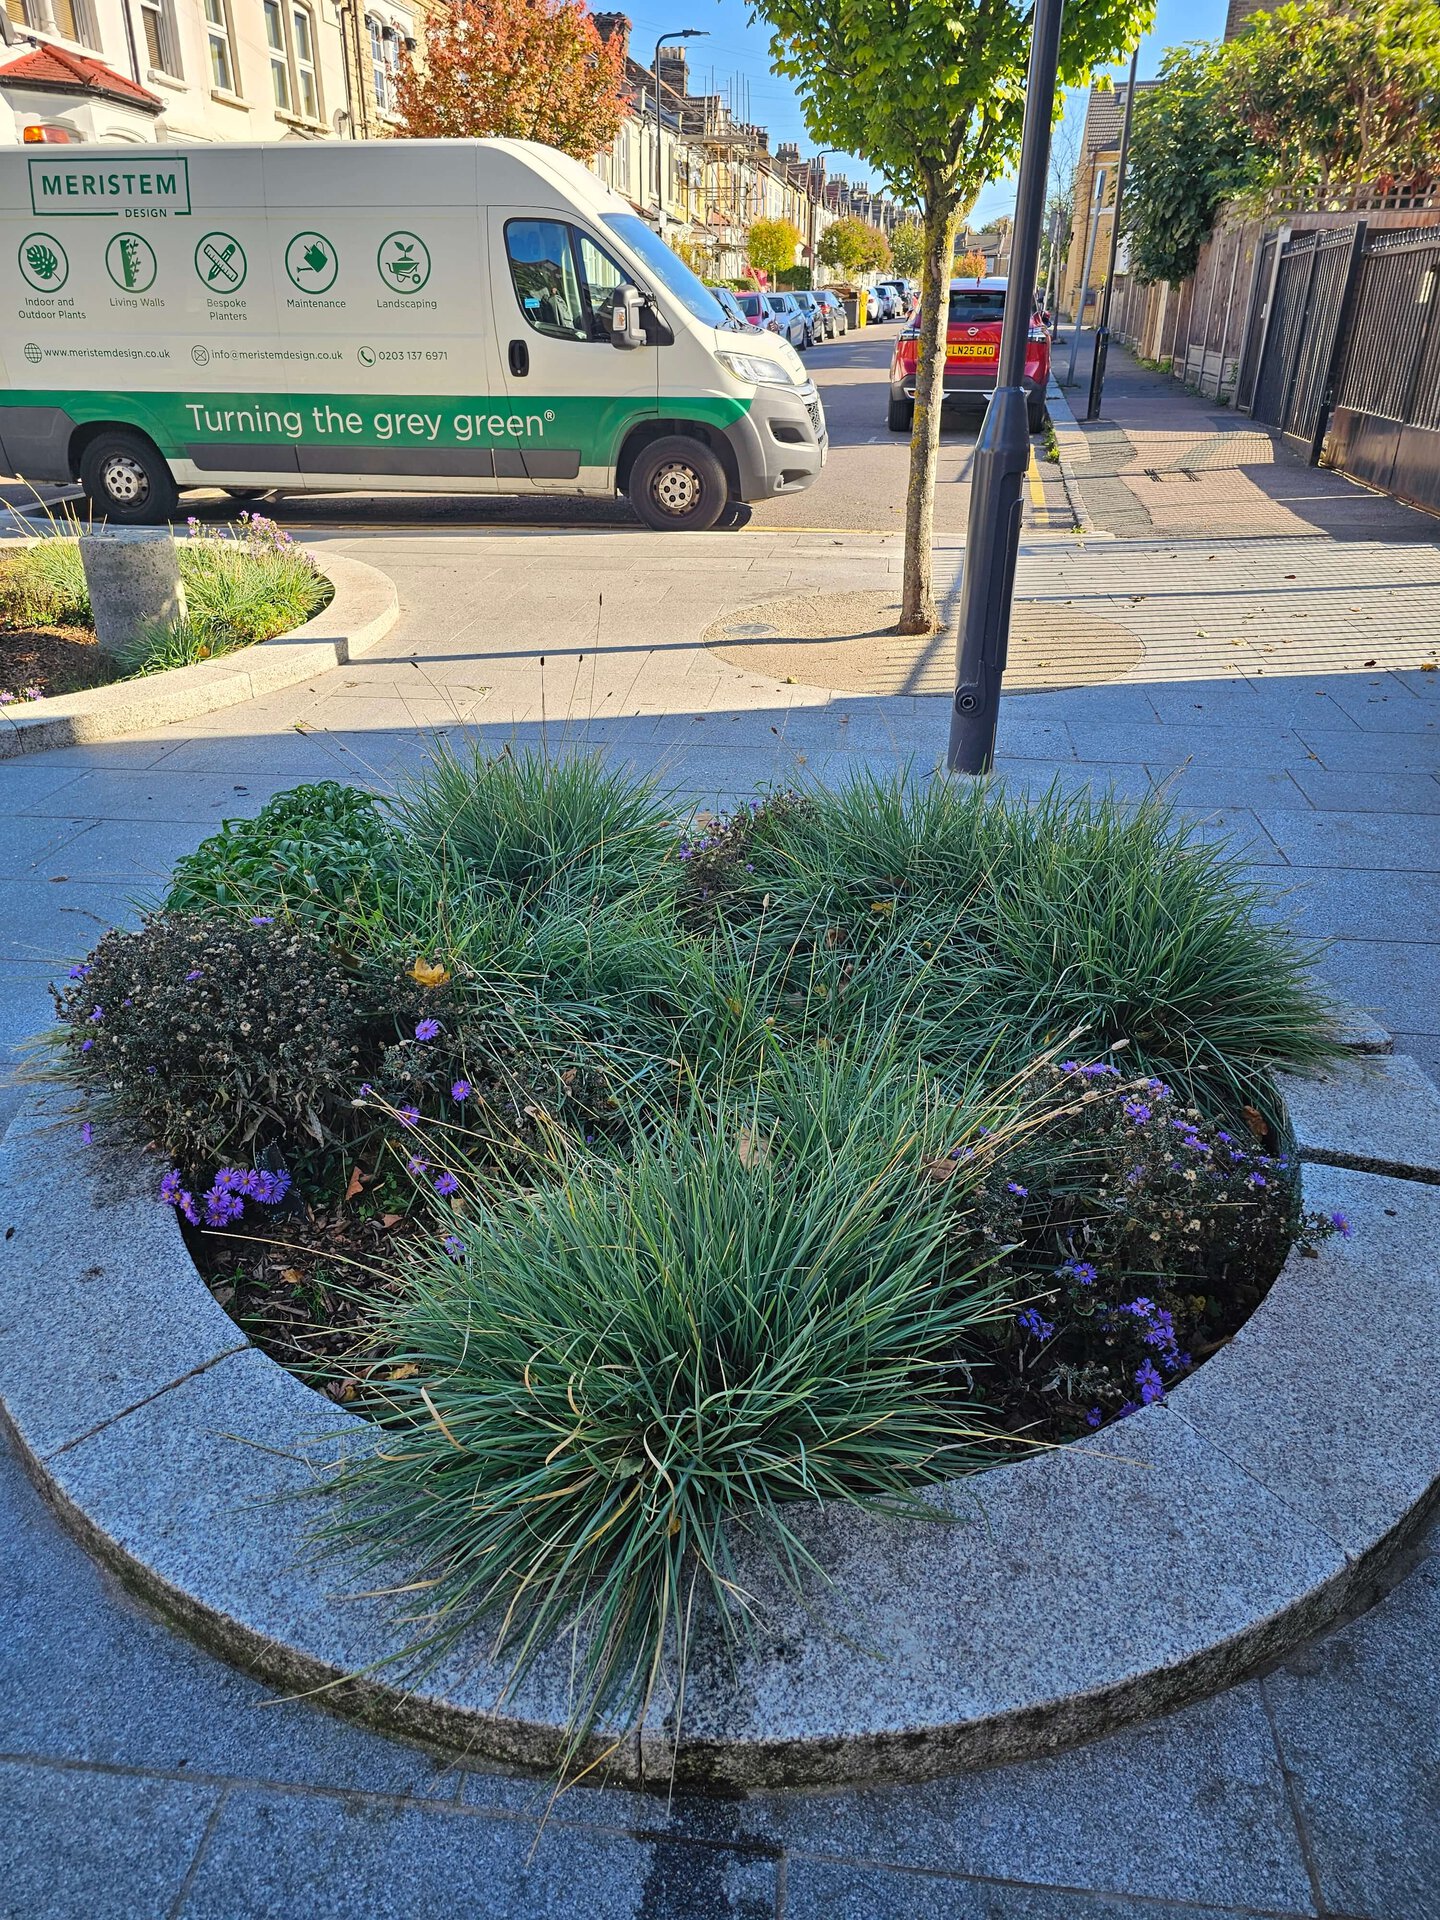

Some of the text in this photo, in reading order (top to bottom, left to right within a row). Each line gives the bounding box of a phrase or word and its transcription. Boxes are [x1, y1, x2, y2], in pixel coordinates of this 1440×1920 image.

[42, 174, 177, 195] MERISTEM
[125, 209, 167, 218] DESIGN
[25, 298, 74, 306] Indoor and
[109, 298, 165, 309] Living Walls
[207, 299, 247, 309] Bespoke
[286, 298, 346, 309] Maintenance
[376, 299, 437, 310] Landscaping
[18, 310, 86, 319] Outdoor Plants
[209, 312, 248, 321] Planters
[44, 349, 171, 361] www.meristemdesign.co.uk
[211, 349, 343, 362] info@meristemdesign.co.uk
[952, 346, 975, 355] LN25
[379, 351, 448, 361] 0203 137 6971
[186, 404, 302, 437] Turning
[312, 405, 362, 434] the
[373, 412, 442, 440] grey
